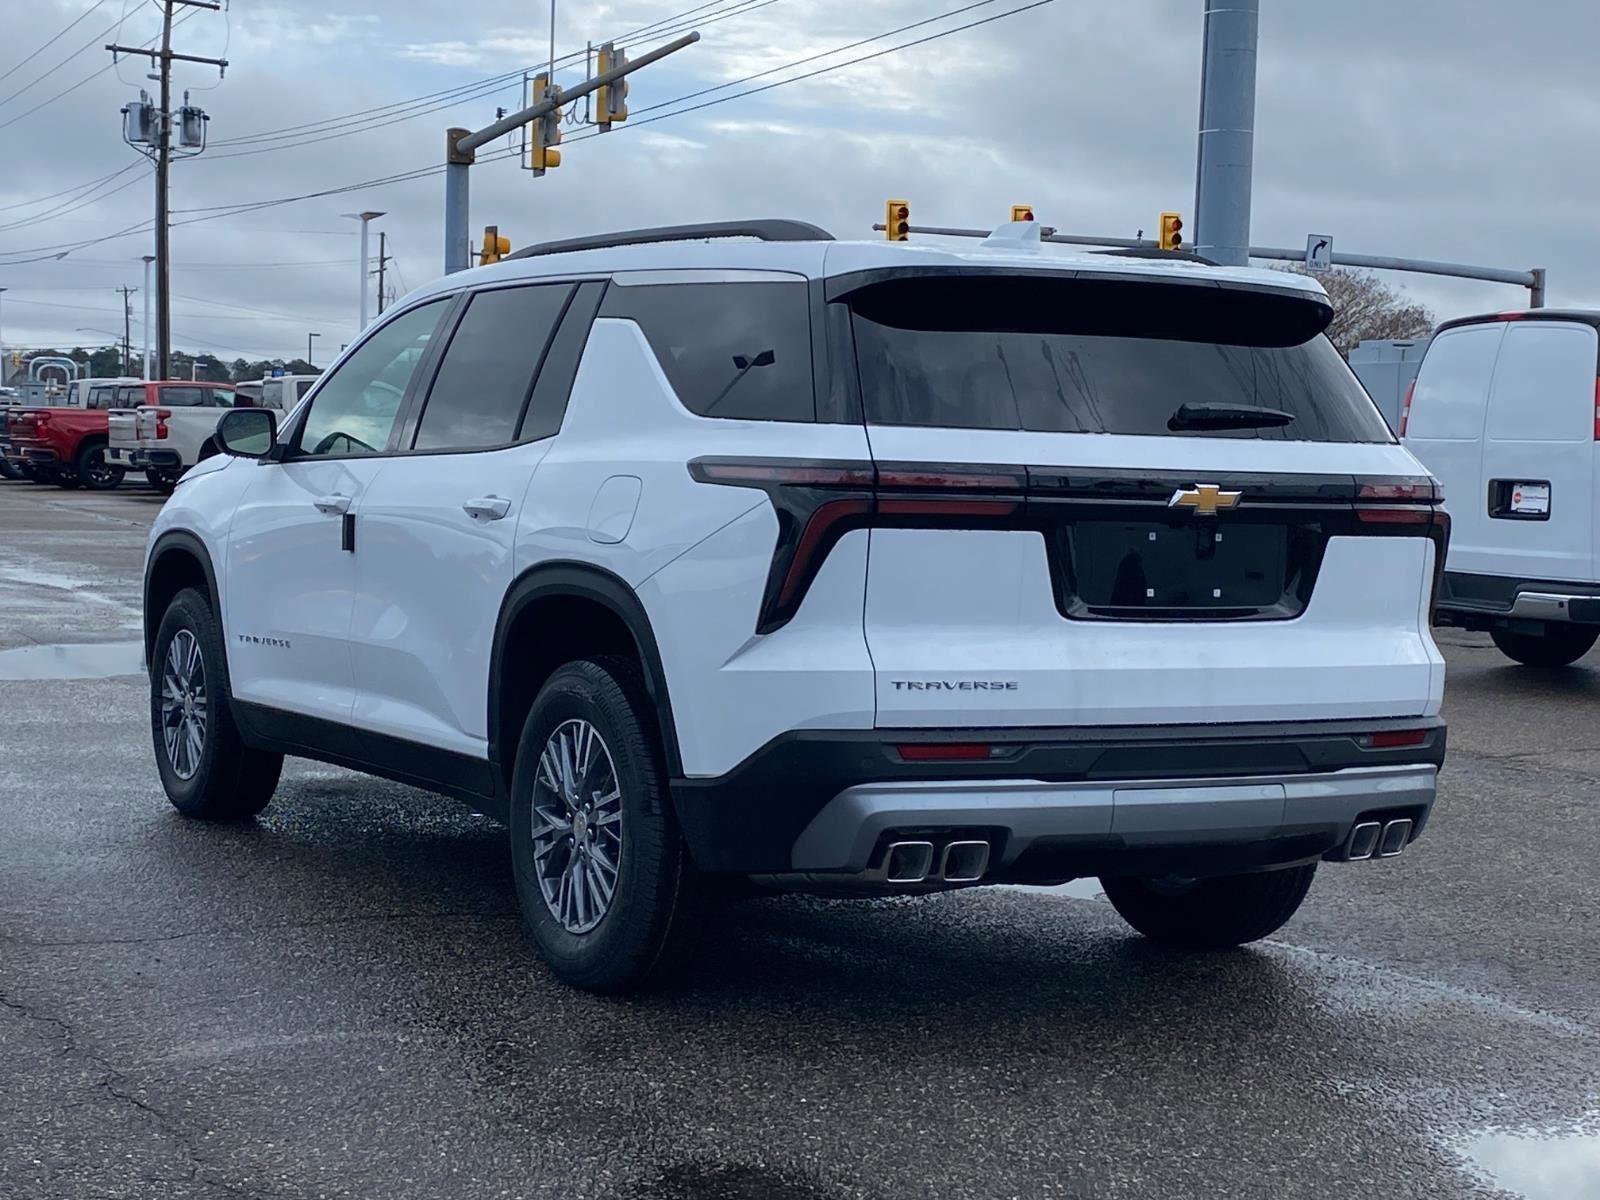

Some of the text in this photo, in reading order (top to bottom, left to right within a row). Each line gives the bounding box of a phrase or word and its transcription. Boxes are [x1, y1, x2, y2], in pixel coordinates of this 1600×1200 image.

[1308, 260, 1328, 269] ONLY
[238, 634, 291, 648] TRAVERSE
[891, 680, 1018, 690] TRAVERSE
